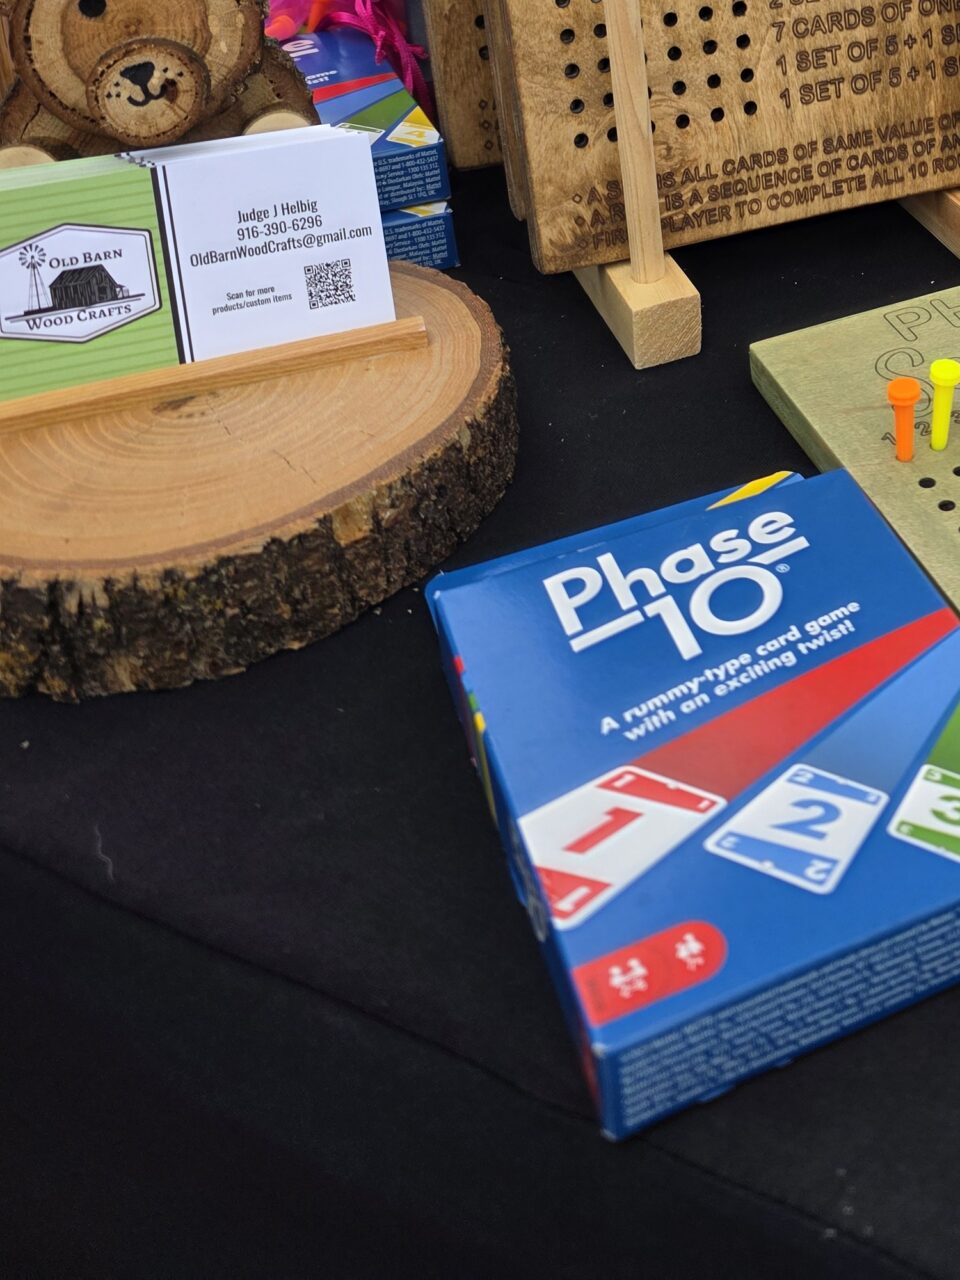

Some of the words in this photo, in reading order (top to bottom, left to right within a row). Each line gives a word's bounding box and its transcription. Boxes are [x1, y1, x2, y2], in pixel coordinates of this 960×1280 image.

[771, 21, 786, 42] 7
[792, 6, 876, 38] CARDS
[881, 0, 912, 23] OF
[388, 154, 414, 162] trademarks
[237, 215, 322, 241] 916-390-6296
[238, 209, 269, 224] Judge
[274, 205, 277, 217] J
[282, 199, 318, 216] Helbig
[190, 225, 373, 268] OldBarnWoodCrafts@gmail.com
[212, 297, 272, 316] products/custom
[273, 292, 292, 304] items
[226, 290, 244, 301] Scan
[246, 289, 256, 298] for
[257, 286, 275, 296] more
[542, 511, 796, 638] Phase
[644, 564, 784, 661] 10
[600, 716, 620, 736] A
[623, 652, 752, 723] rummy-type
[756, 625, 802, 656] card
[804, 601, 861, 635] game
[623, 709, 677, 741] with
[679, 693, 711, 714] an
[713, 650, 798, 696] exciting
[798, 620, 856, 655] twist!
[562, 806, 645, 854] 1
[769, 798, 842, 841] 2
